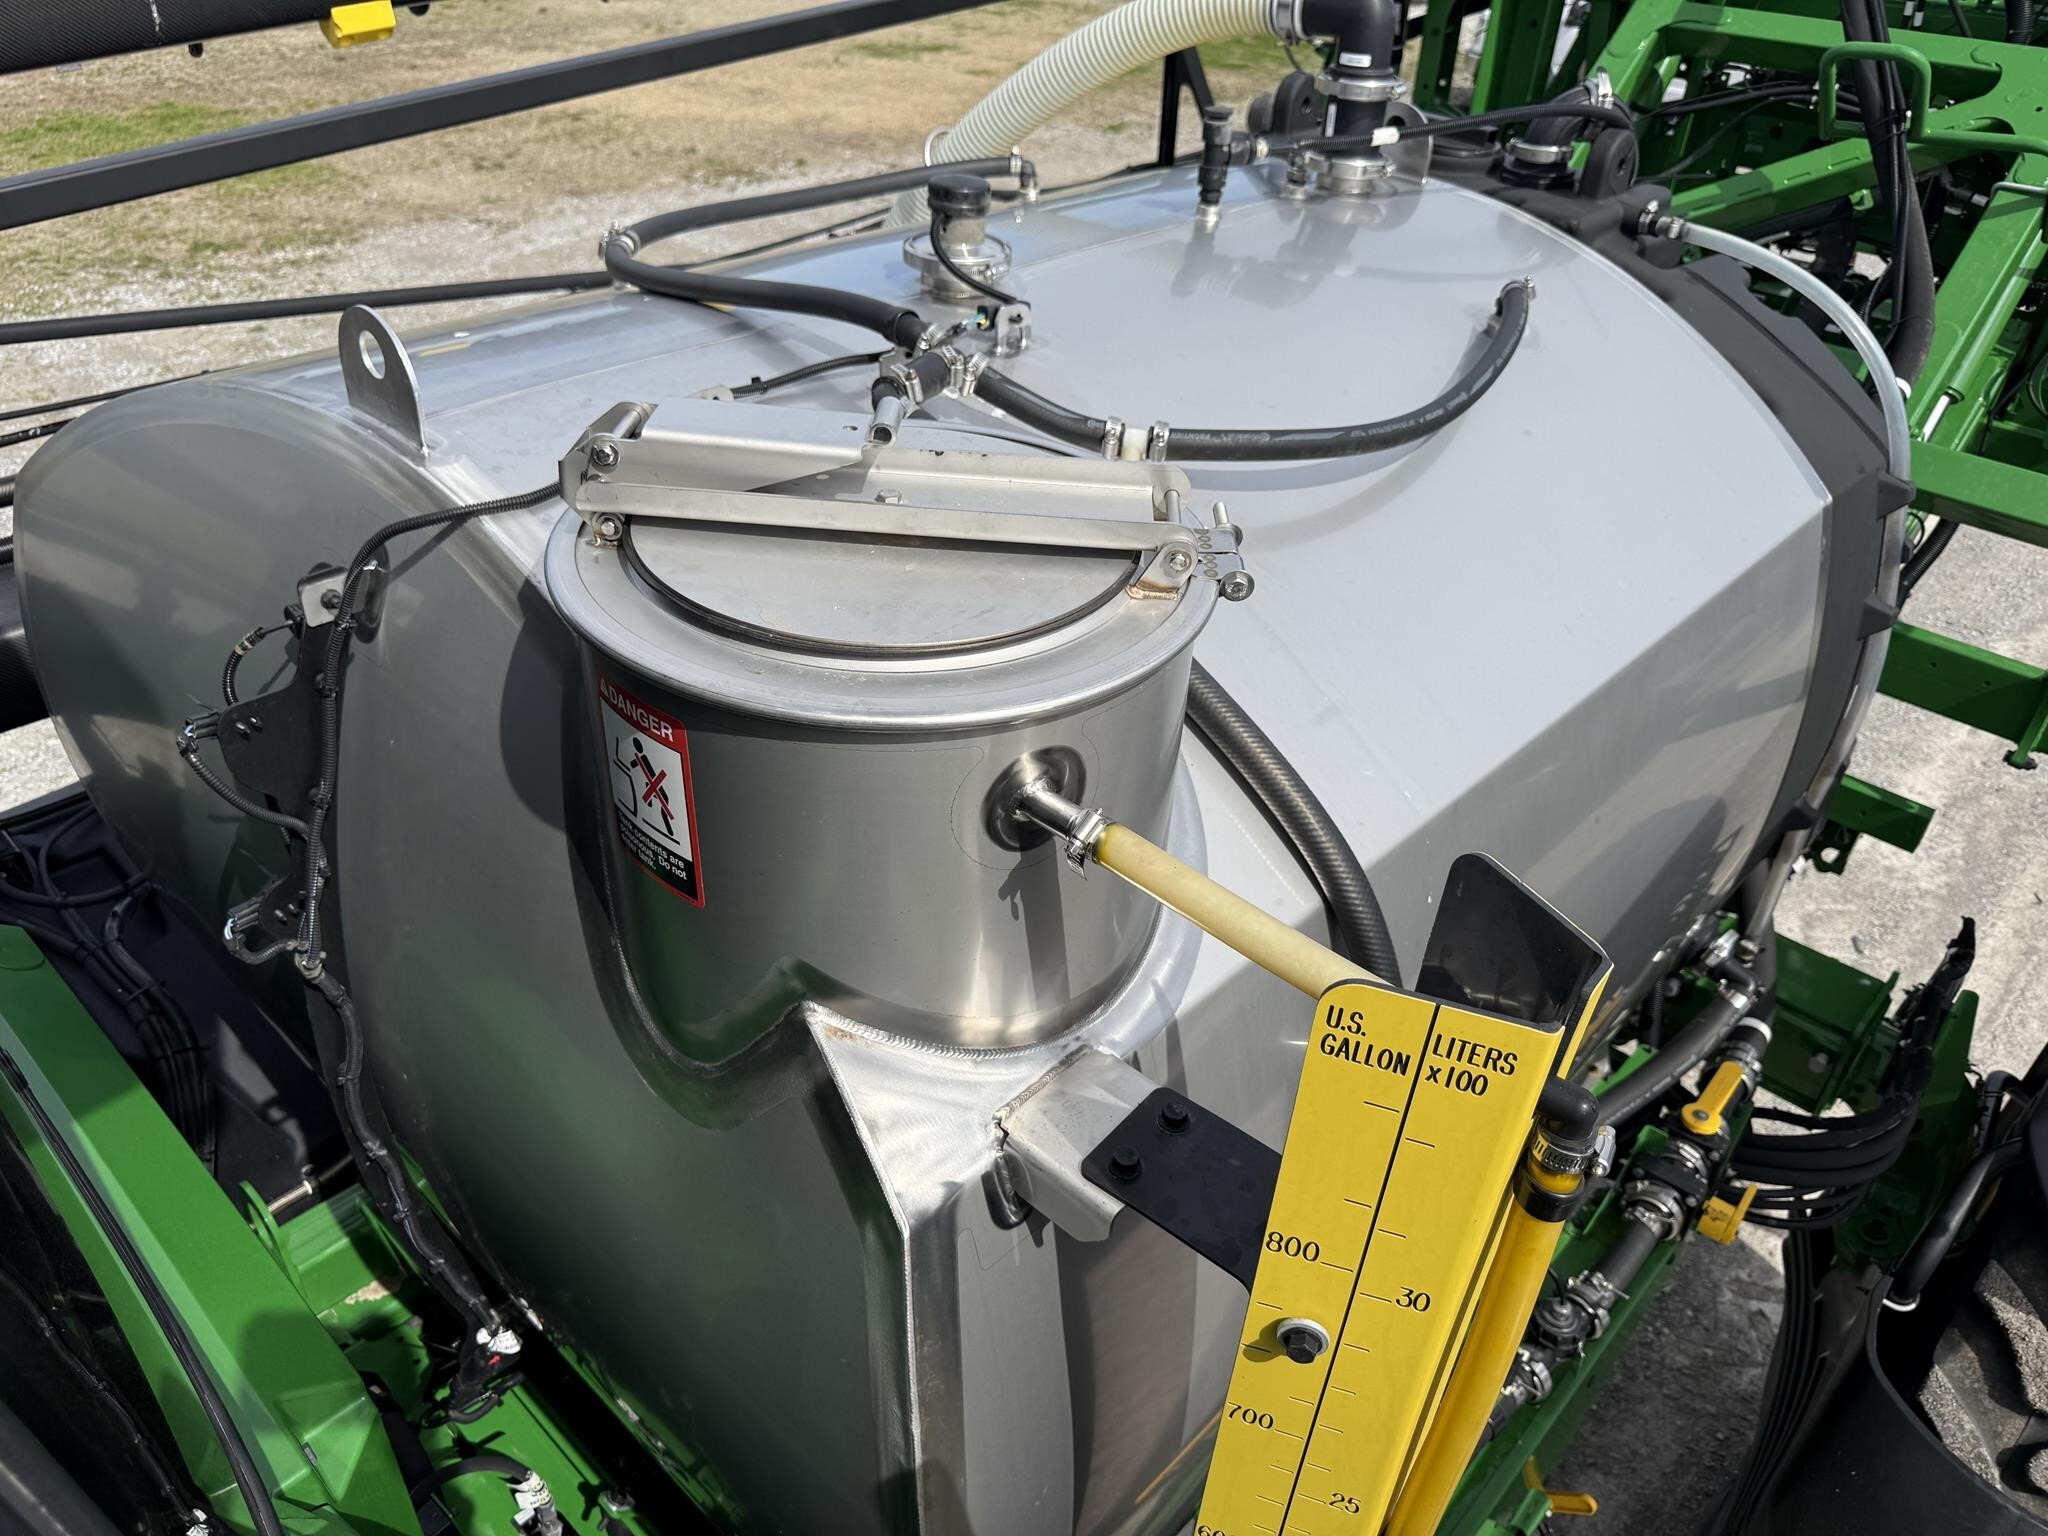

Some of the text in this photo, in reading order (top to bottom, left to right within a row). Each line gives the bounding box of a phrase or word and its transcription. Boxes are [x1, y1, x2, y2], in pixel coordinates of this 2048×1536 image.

[608, 686, 674, 742] DANGER
[634, 829, 668, 859] contents
[669, 855, 685, 869] are
[658, 855, 671, 870] Do
[672, 866, 687, 880] not
[1325, 1004, 1367, 1037] U.S.
[1320, 1033, 1412, 1077] GALLON
[1431, 1033, 1519, 1077] LITERS
[1265, 1231, 1321, 1262] 800
[1395, 1286, 1432, 1312] 30
[1227, 1401, 1275, 1430] 700
[1328, 1491, 1362, 1515] 25
